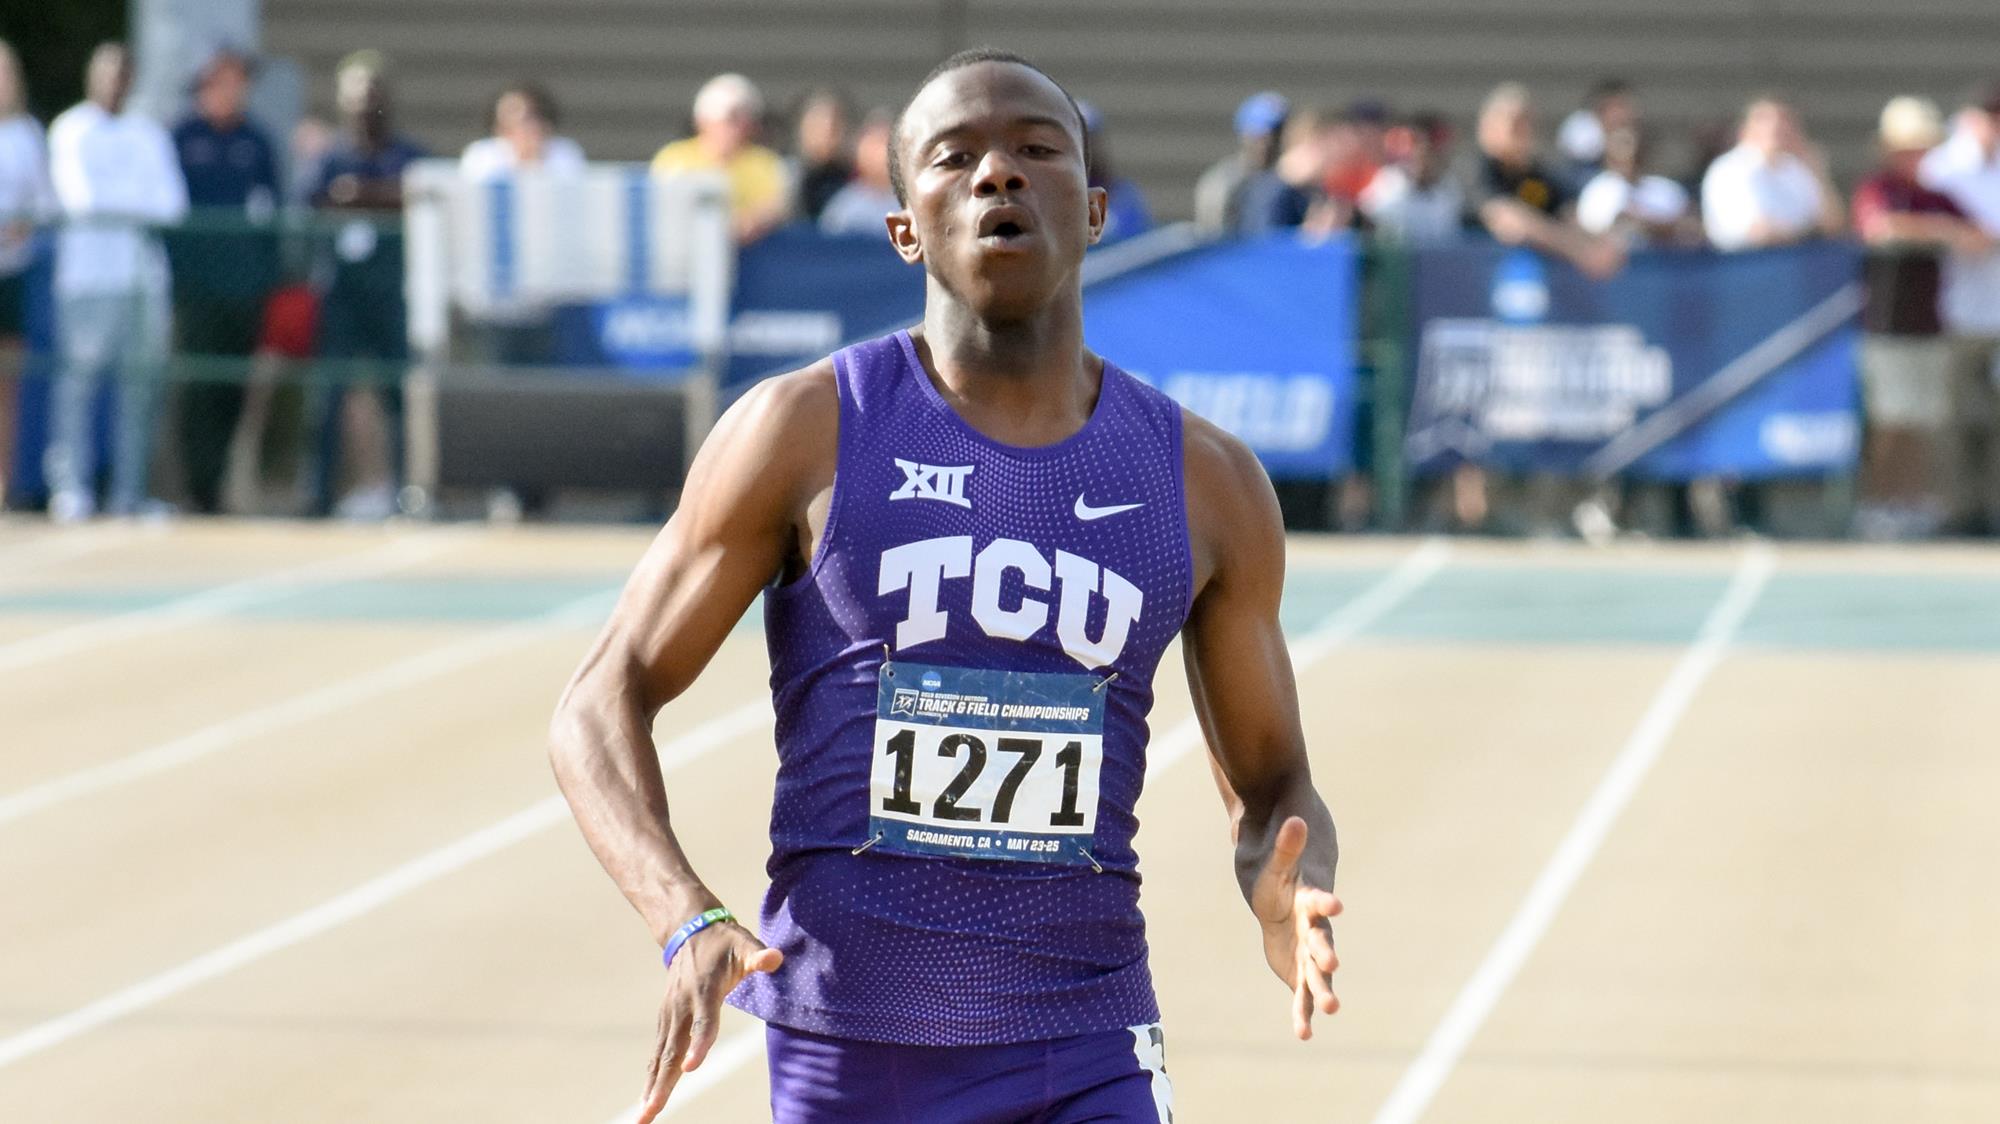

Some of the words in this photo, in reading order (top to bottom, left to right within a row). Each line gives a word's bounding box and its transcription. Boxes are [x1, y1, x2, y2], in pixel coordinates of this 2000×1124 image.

[890, 457, 975, 509] XII
[878, 535, 1143, 670] TCU
[919, 698, 957, 713] TRACK
[956, 701, 966, 714] &
[966, 702, 999, 717] FIELD
[1001, 704, 1090, 720] CHAMPIONSHIPS
[883, 729, 1084, 826] 1271
[907, 829, 975, 848] SACRAMENTO,
[977, 836, 991, 848] CA
[1007, 838, 1029, 850] MAY
[1030, 840, 1060, 852] 23-25
